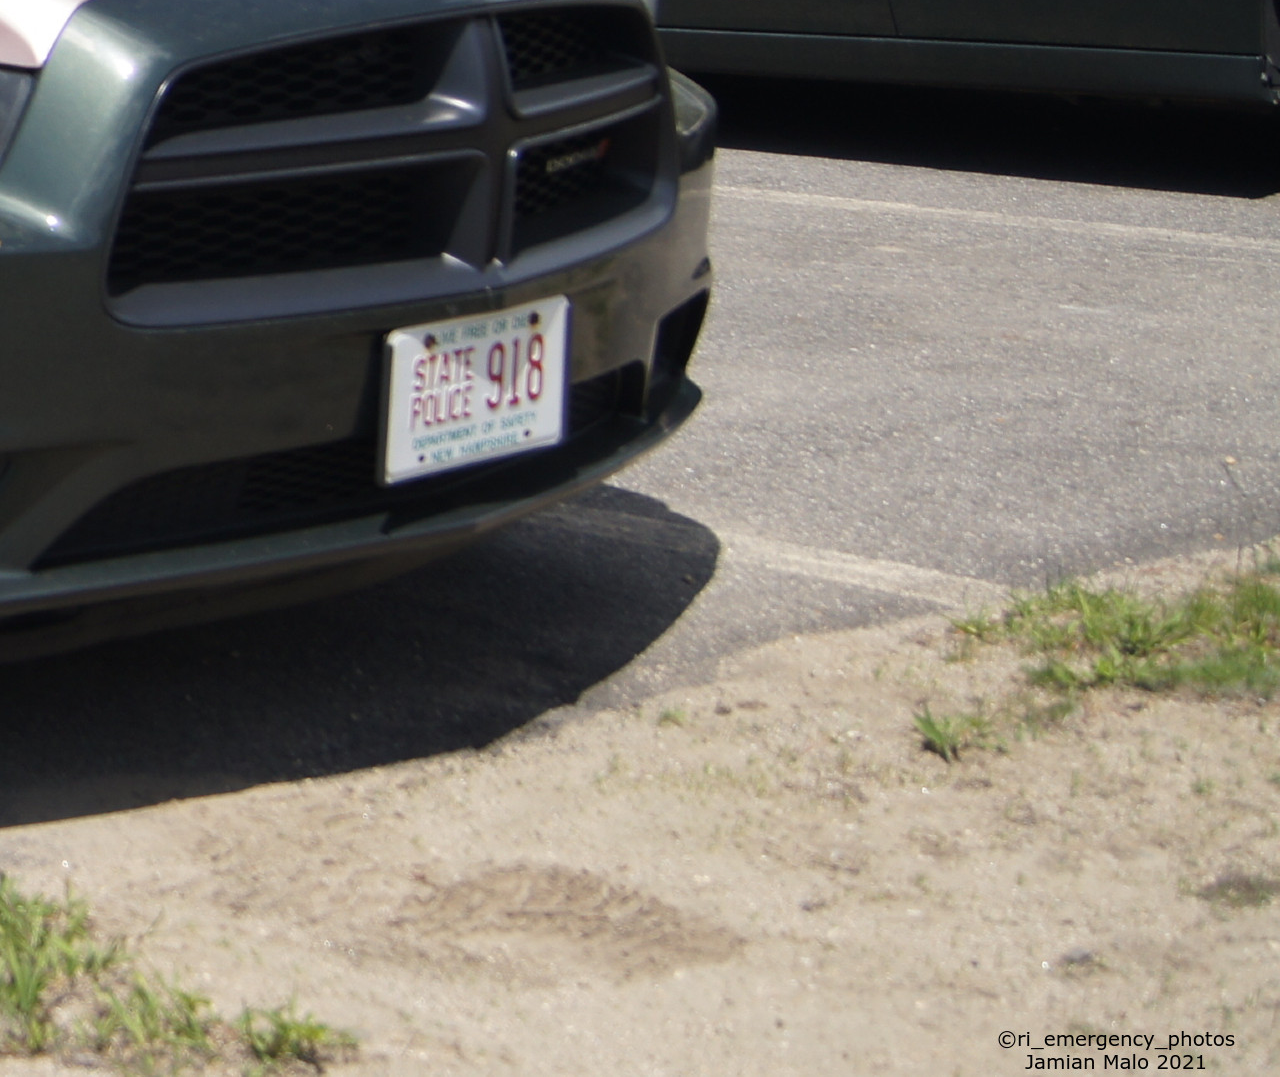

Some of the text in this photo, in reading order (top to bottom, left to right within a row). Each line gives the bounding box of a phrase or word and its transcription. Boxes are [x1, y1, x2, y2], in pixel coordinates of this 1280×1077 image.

[413, 333, 545, 410] STATE 918
[410, 383, 474, 430] POLICE
